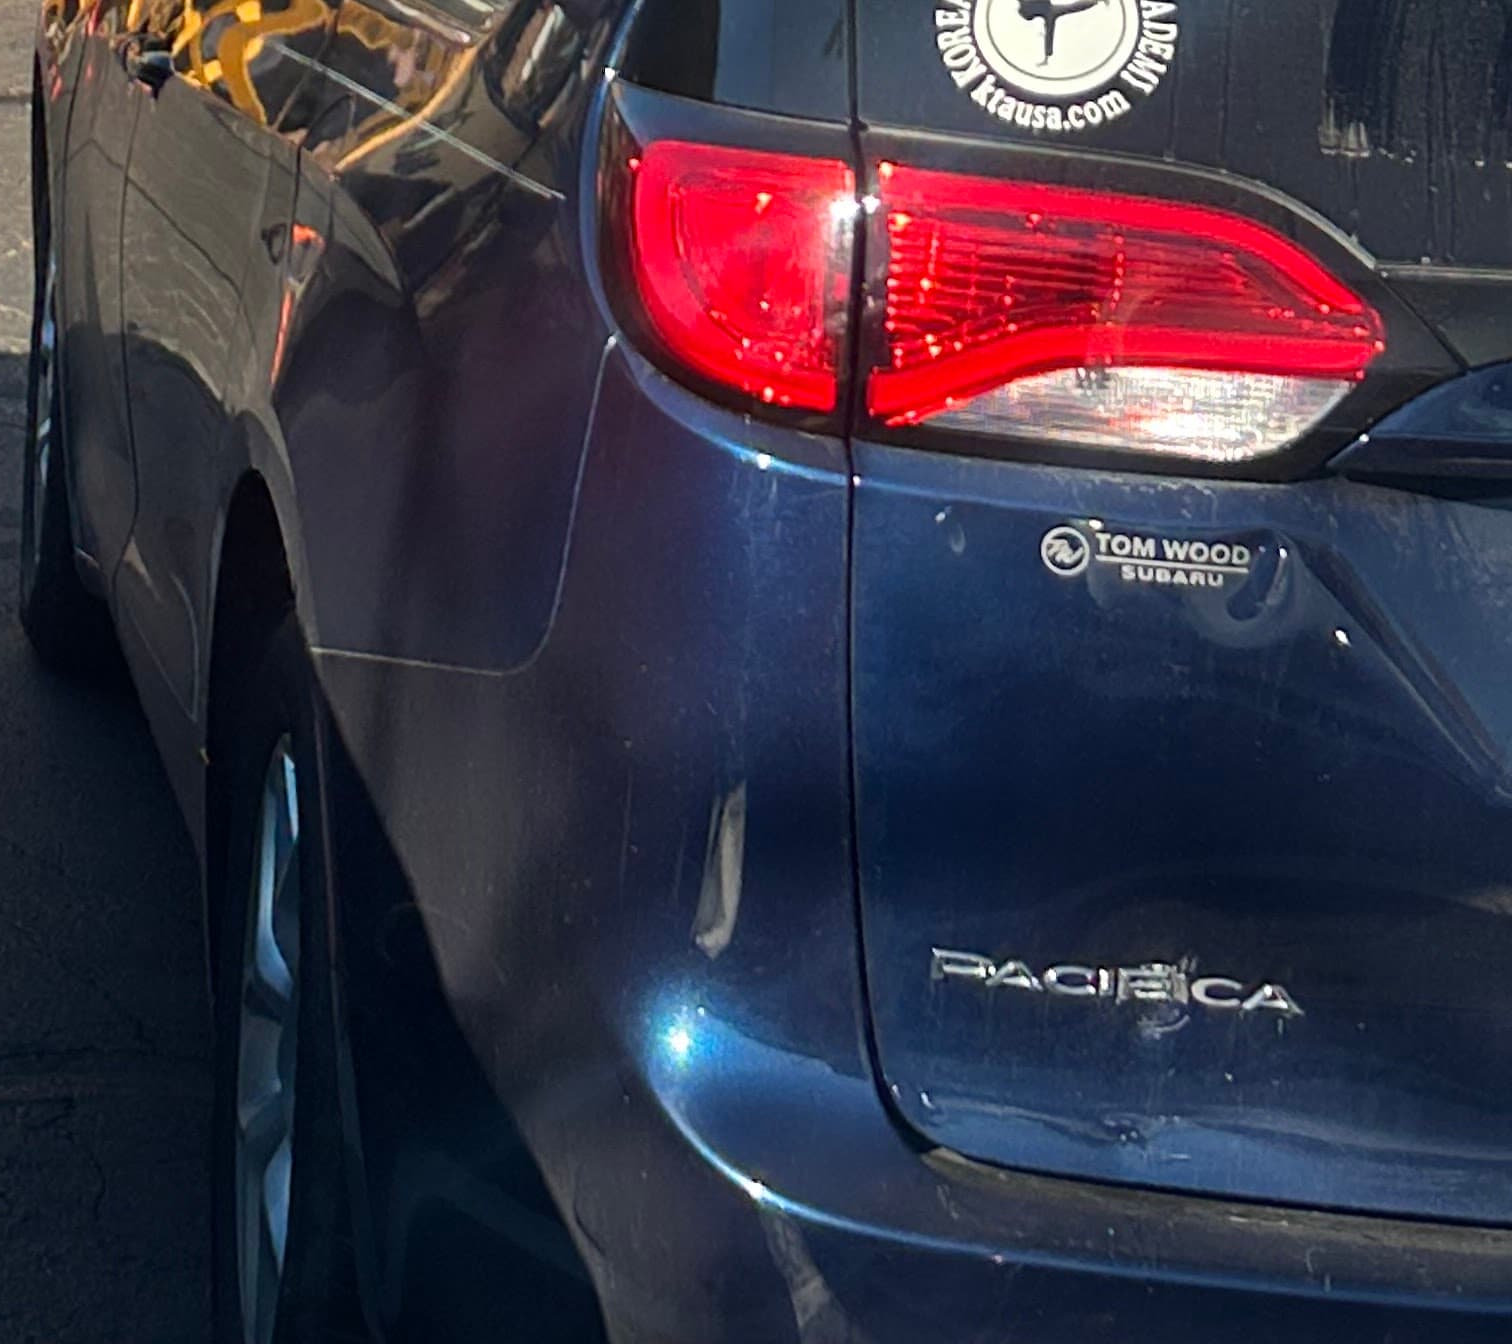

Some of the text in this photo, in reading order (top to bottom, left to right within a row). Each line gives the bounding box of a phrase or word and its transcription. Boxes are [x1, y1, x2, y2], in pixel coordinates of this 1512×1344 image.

[1096, 531, 1156, 559] TOM
[1163, 539, 1251, 566] WOOD
[1121, 565, 1224, 587] SUBARU
